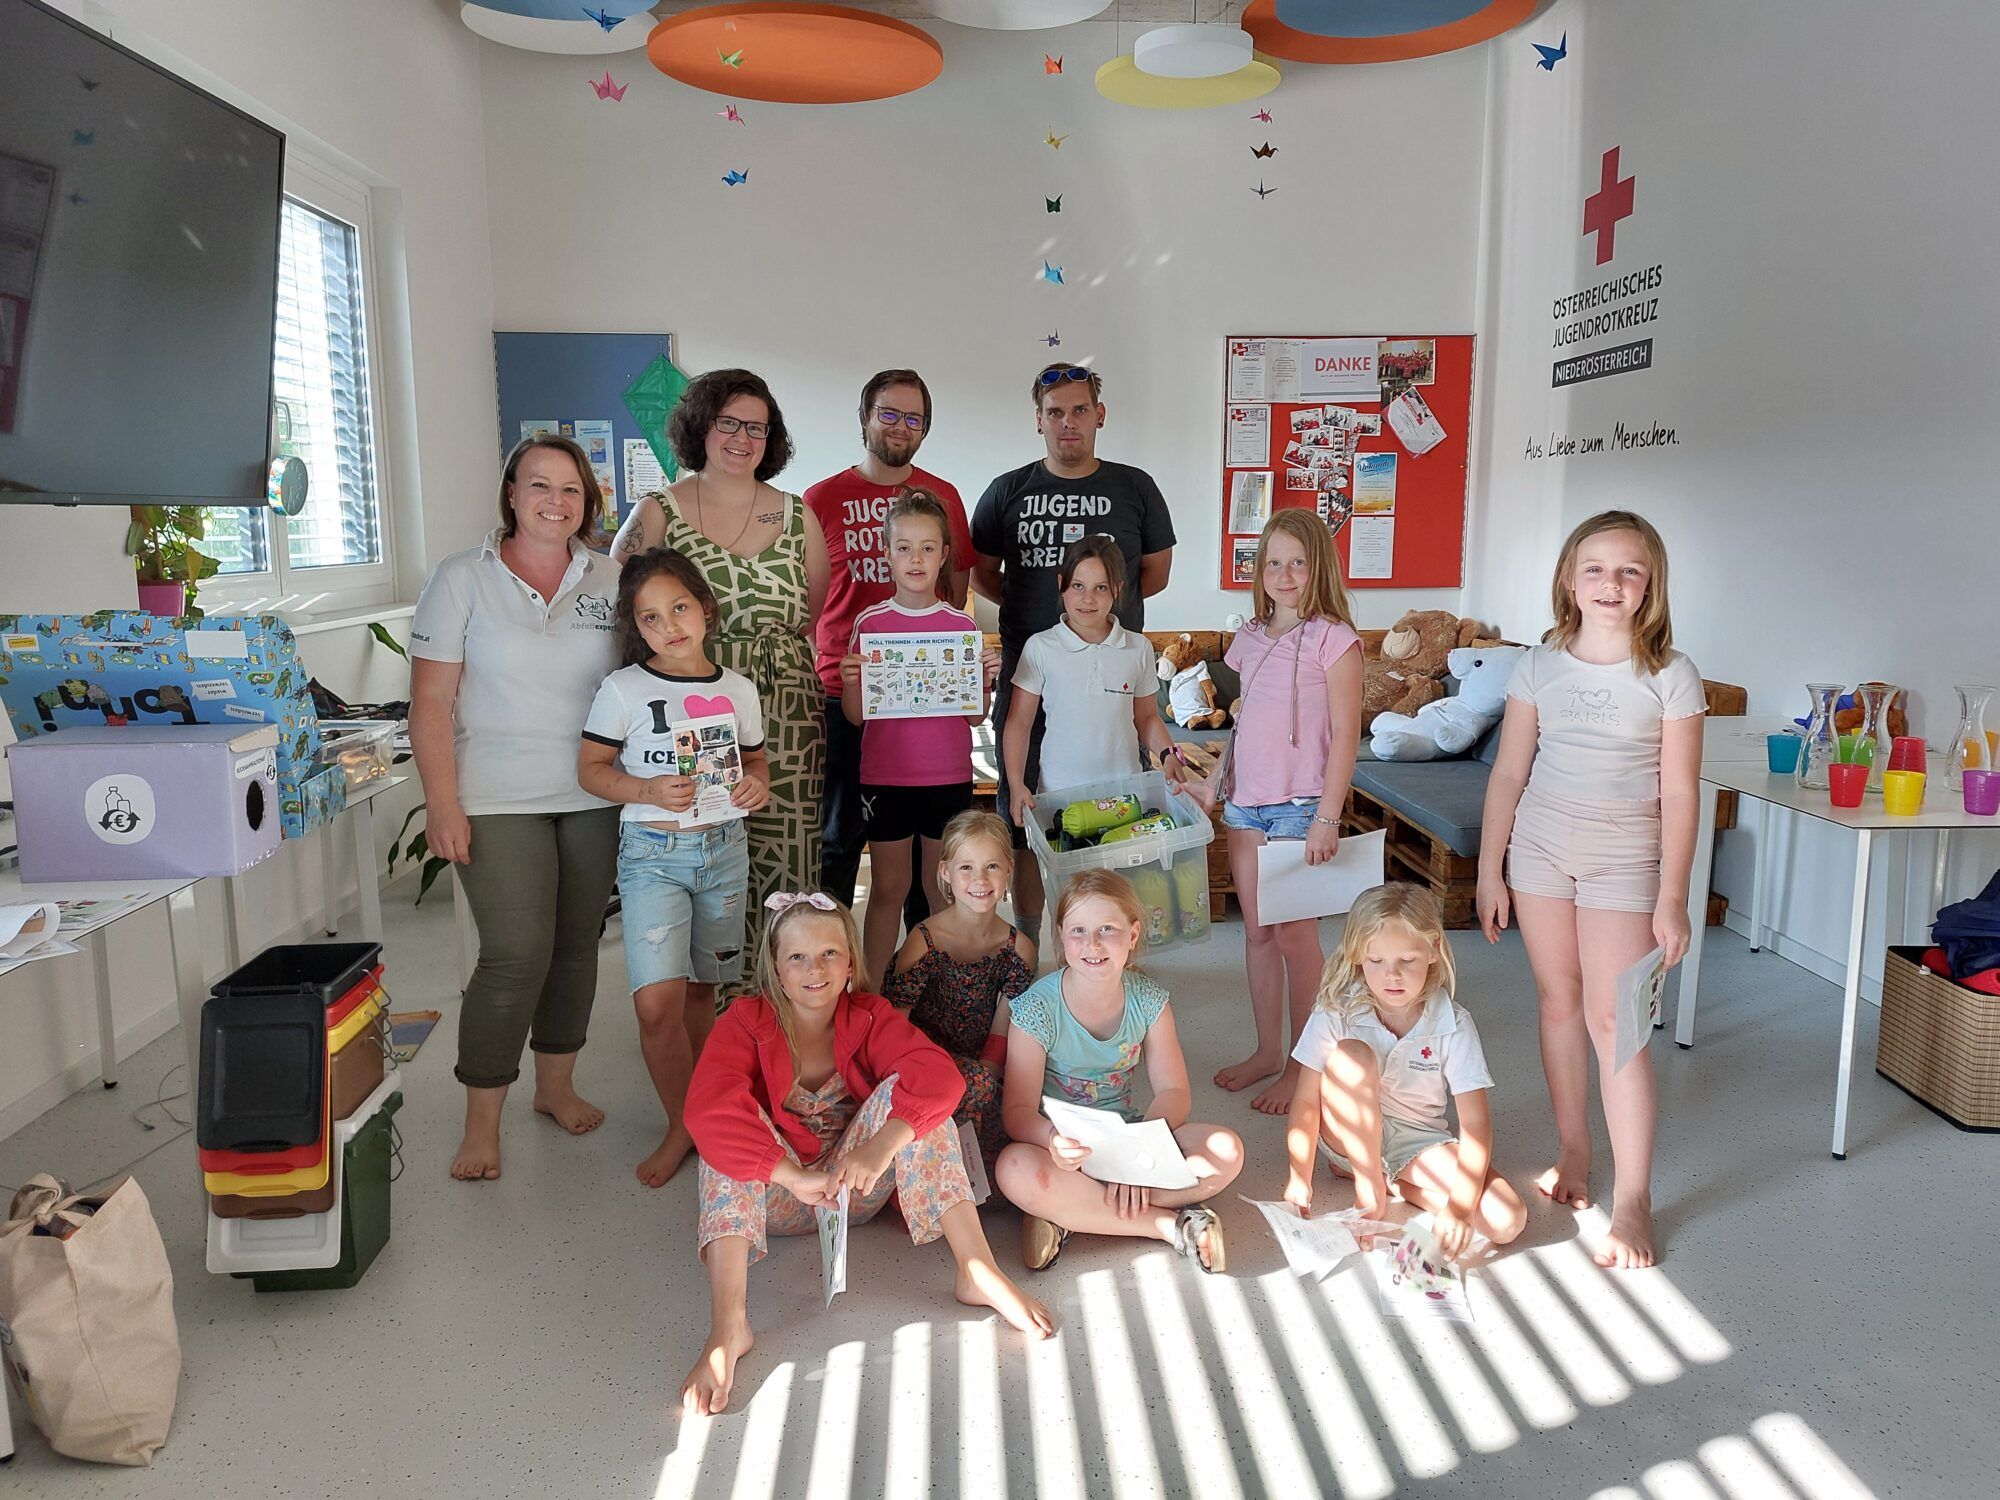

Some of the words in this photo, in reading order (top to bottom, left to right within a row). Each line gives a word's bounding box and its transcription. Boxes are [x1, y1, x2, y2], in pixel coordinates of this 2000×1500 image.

[1553, 264, 1662, 320] ÖSTERREICHISCHES
[1553, 298, 1658, 348] JUGENDROTKREUZ
[1315, 356, 1372, 372] DANKE
[1555, 344, 1648, 382] NIEDERÖSTERREICH
[1525, 436, 1543, 460] Aus
[1549, 432, 1576, 458] Liebe
[1580, 437, 1604, 454] zum
[1611, 420, 1680, 451] Menschen.
[1020, 494, 1112, 518] JUGEND
[844, 526, 884, 552] ROT
[1018, 520, 1058, 545] ROT
[848, 556, 891, 583] KRE
[647, 700, 671, 734] I
